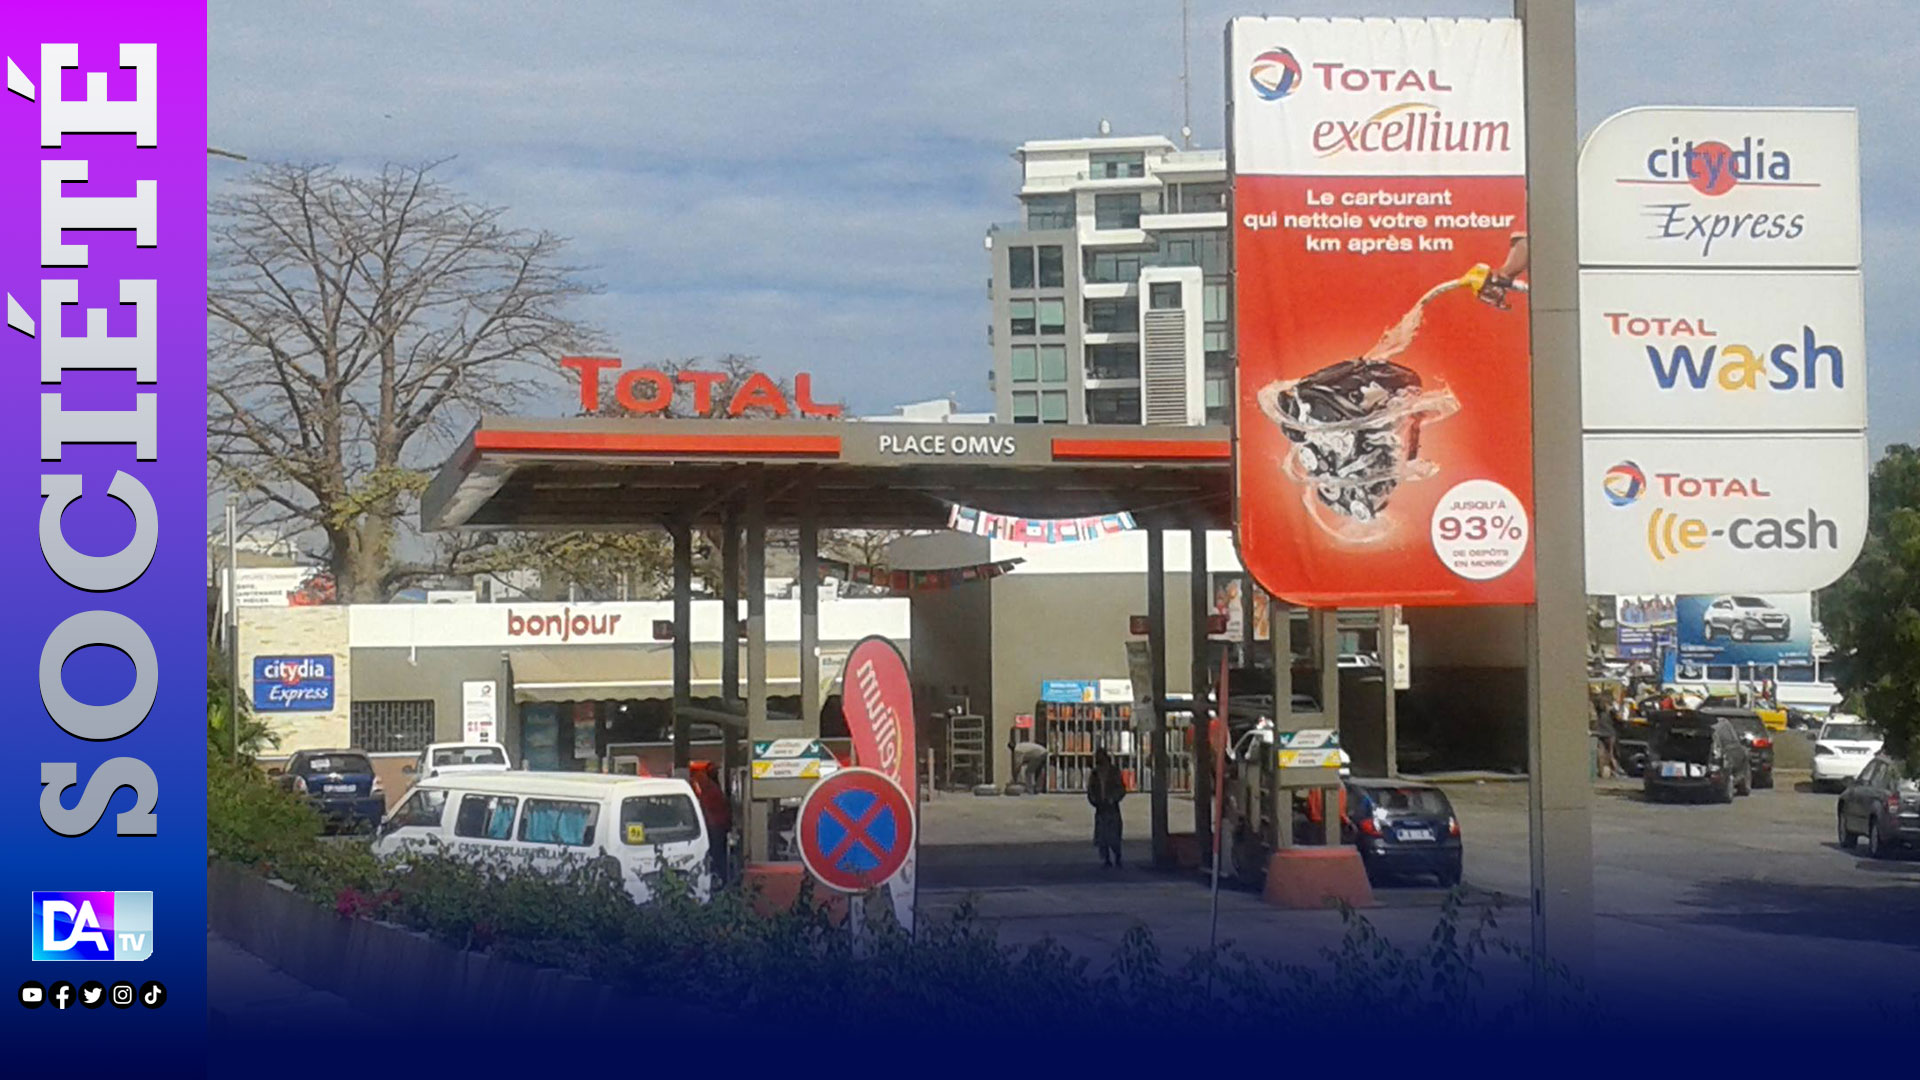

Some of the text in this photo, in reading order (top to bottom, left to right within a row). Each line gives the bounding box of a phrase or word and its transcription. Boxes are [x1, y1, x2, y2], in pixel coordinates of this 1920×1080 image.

[1312, 62, 1452, 92] TOTAL
[1312, 109, 1511, 153] excellium
[1647, 136, 1791, 189] citydia
[1306, 189, 1453, 206] Le carburant
[1243, 212, 1515, 231] qui nettoie votre moteur
[1643, 203, 1805, 257] Express
[1306, 235, 1453, 254] km après km
[1603, 312, 1718, 337] TOTAL
[1646, 325, 1844, 391] wash
[560, 355, 842, 417] TOTAL
[879, 435, 1016, 455] PLACE OMVS
[1655, 473, 1771, 497] TOTAL
[1439, 515, 1522, 540] 93%
[507, 607, 622, 642] bonjour
[263, 659, 325, 681] citydia
[270, 684, 329, 707] Express
